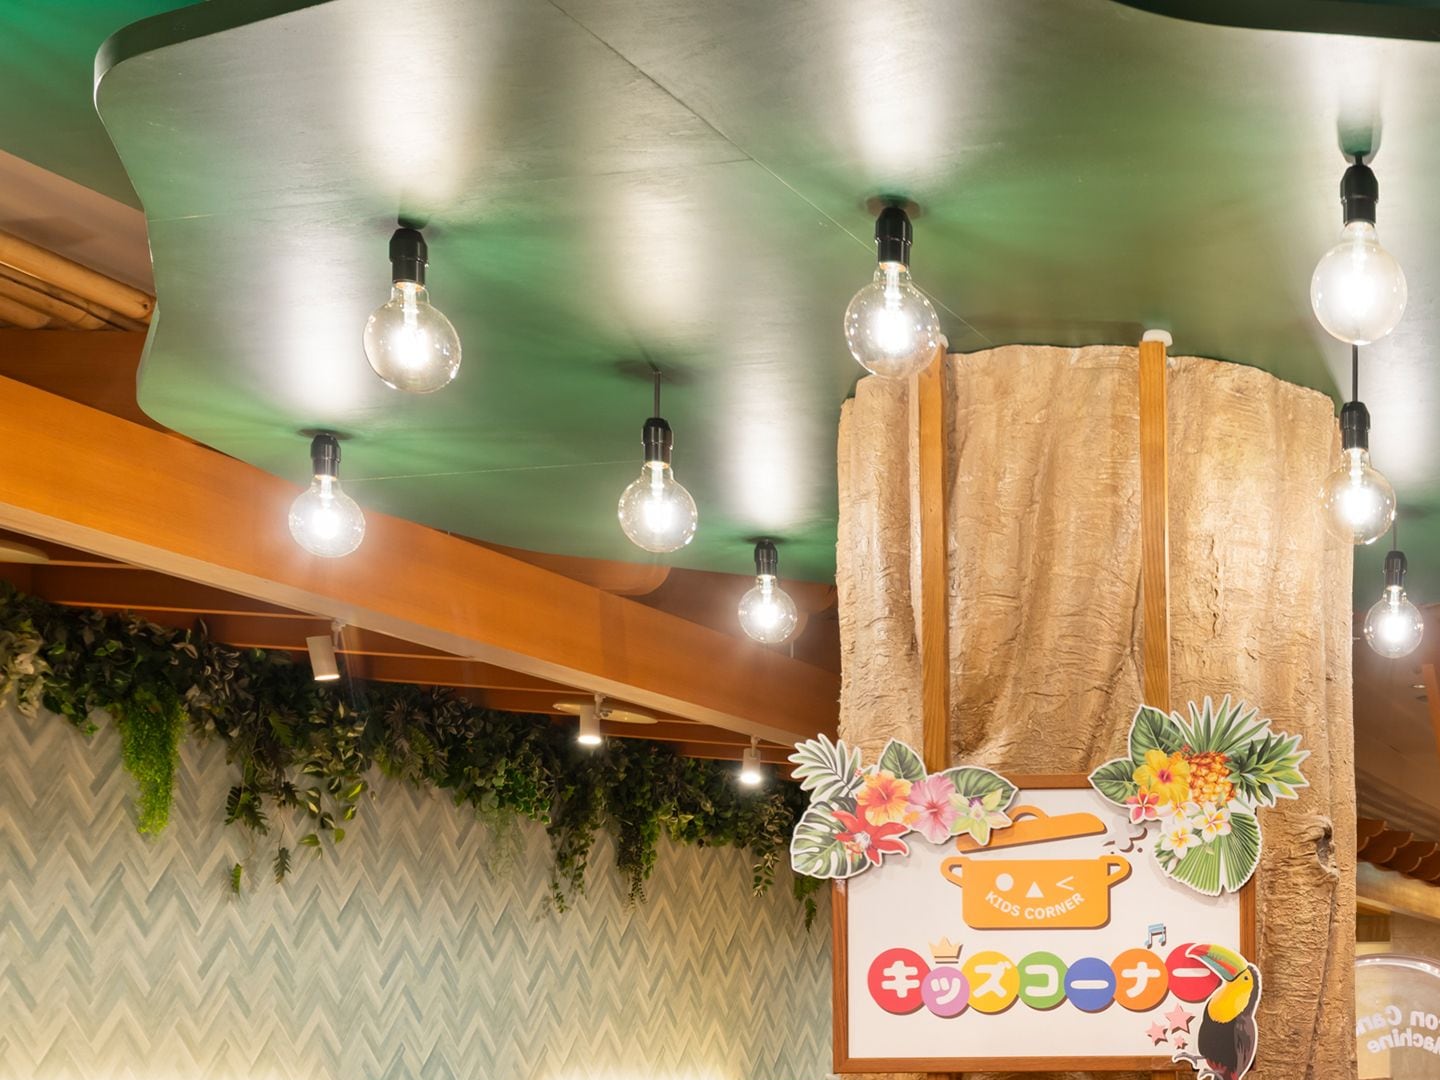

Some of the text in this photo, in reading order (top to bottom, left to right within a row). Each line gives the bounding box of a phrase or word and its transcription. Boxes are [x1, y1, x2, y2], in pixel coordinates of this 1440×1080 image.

[984, 890, 1086, 920] KIDS CORNER
[881, 960, 1212, 1005] キッズコーナー
